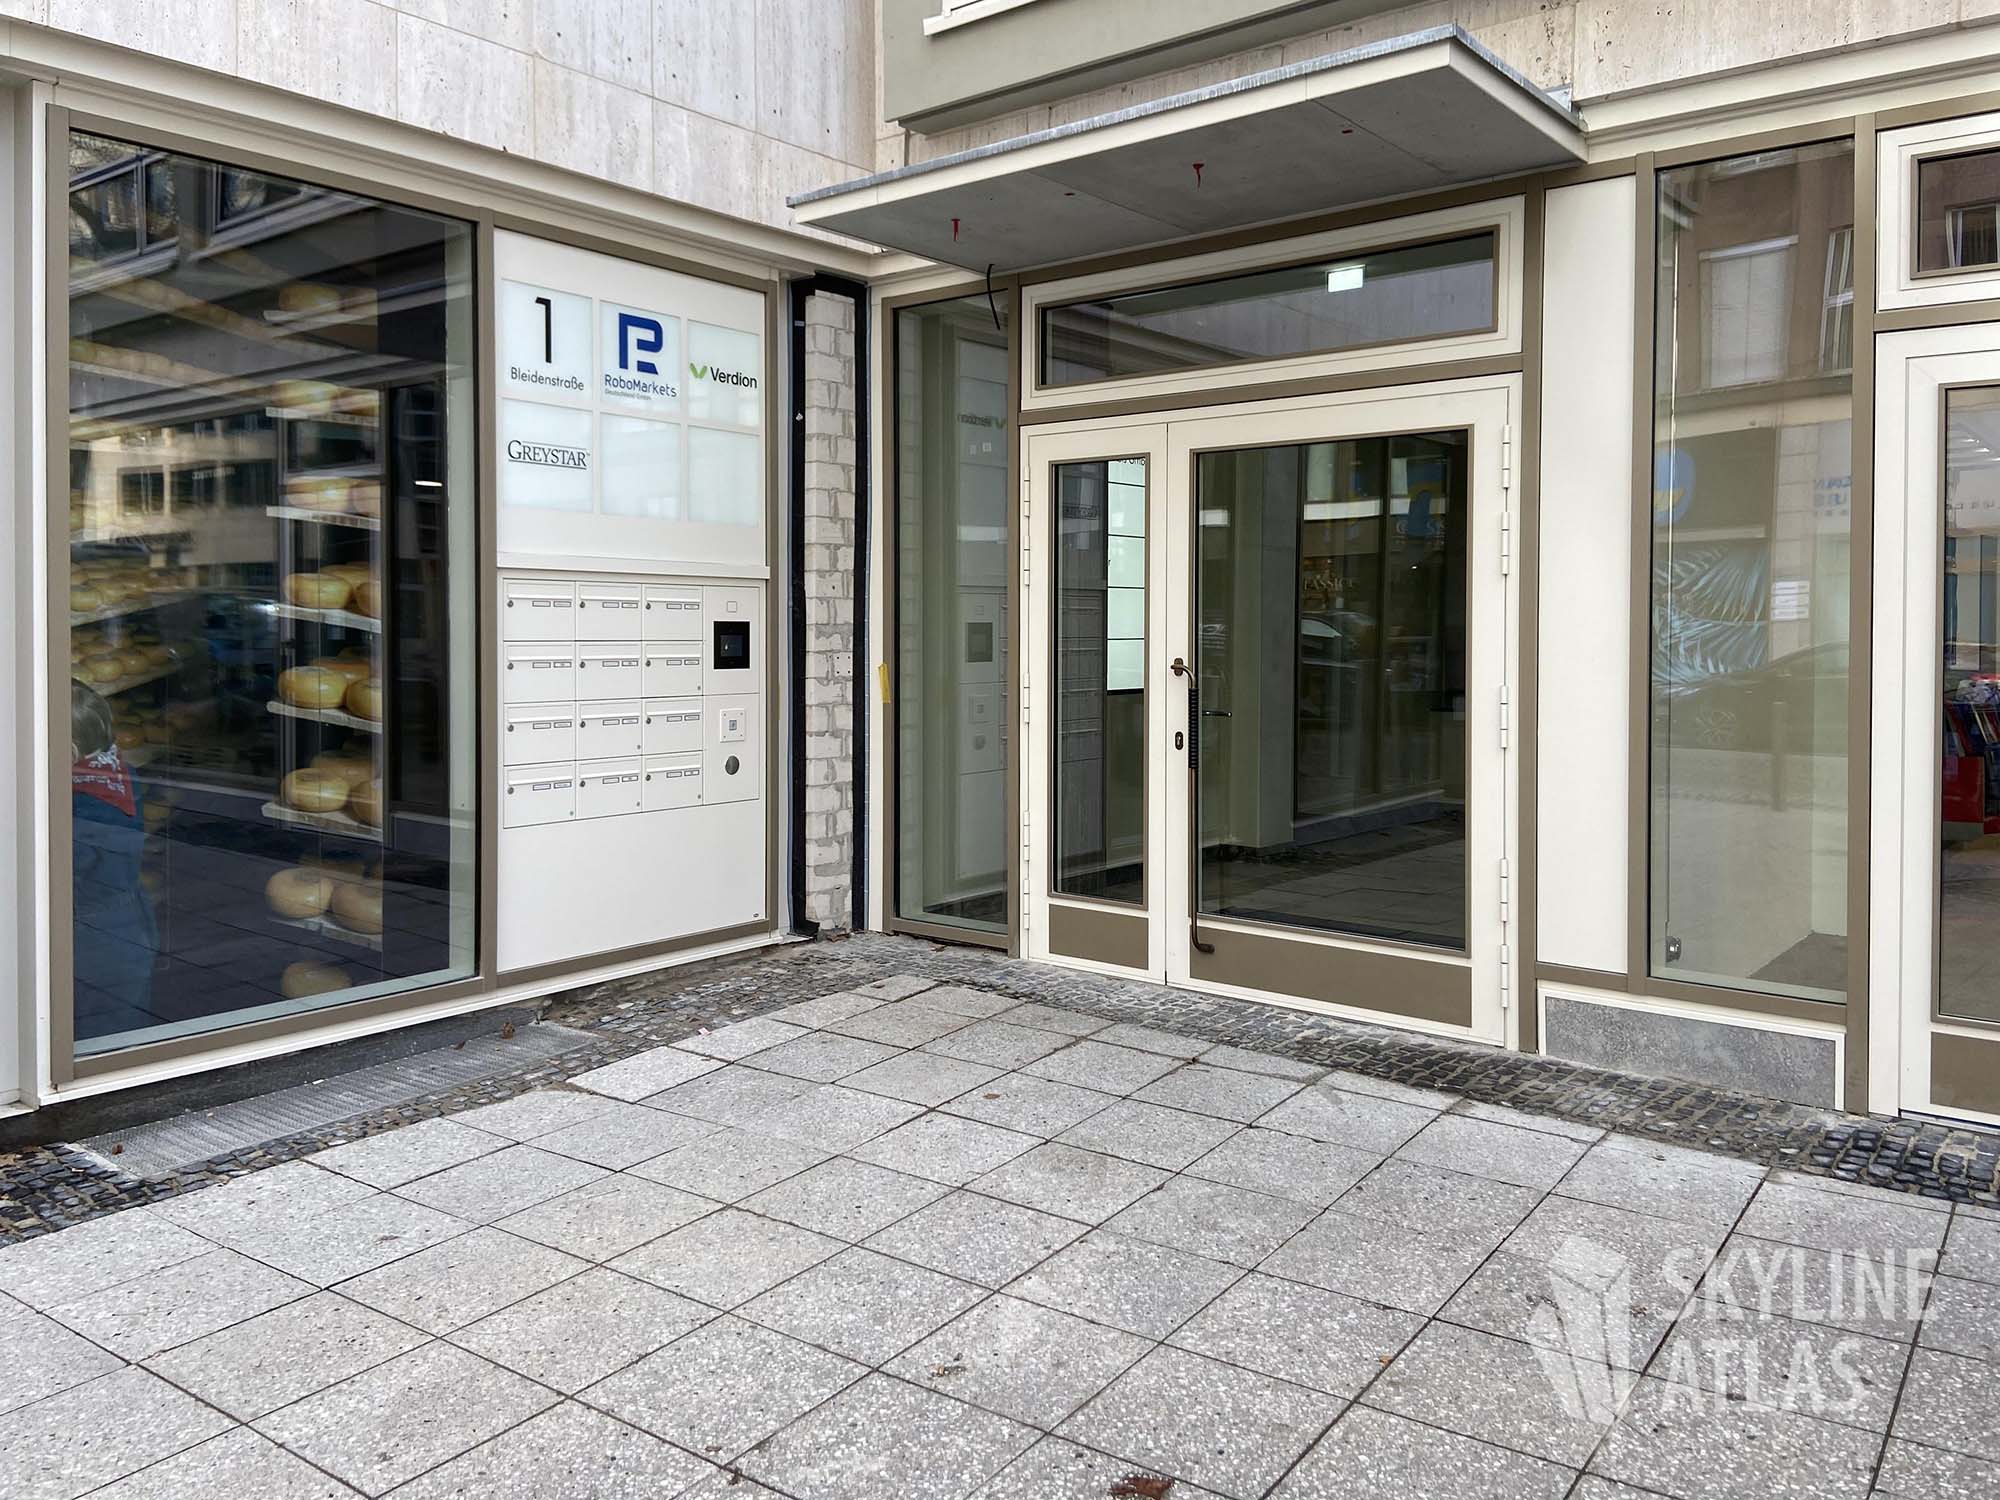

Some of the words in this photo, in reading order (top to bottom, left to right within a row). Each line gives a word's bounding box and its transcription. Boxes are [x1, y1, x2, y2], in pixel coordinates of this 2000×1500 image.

[535, 296, 551, 363] 1
[511, 366, 585, 391] Bleidenstraße
[604, 374, 677, 398] RoboMarkets
[709, 366, 758, 389] Verdion
[507, 439, 587, 468] GREYSTAR
